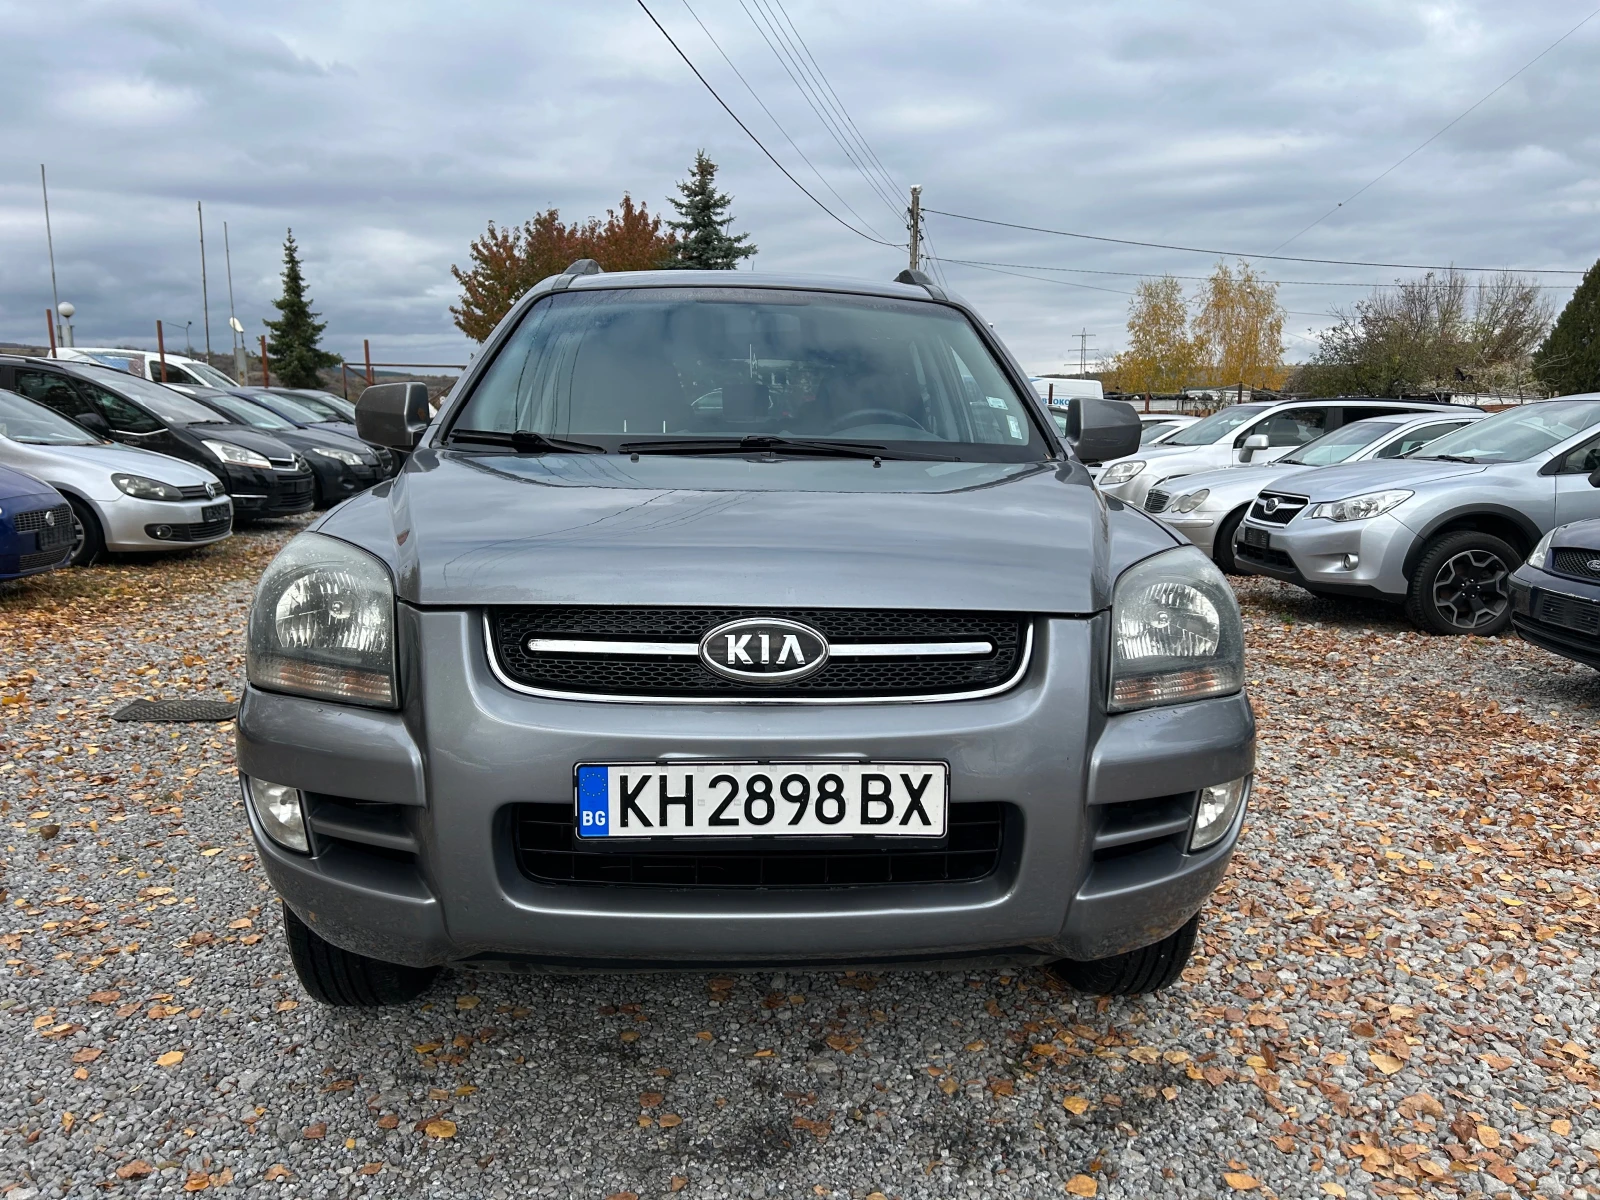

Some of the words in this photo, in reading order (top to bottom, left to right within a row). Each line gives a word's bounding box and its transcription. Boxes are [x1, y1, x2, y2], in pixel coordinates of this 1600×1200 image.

[725, 634, 806, 665] KIA
[619, 774, 694, 827] KH
[708, 774, 846, 826] 2898
[860, 774, 933, 826] BX
[583, 811, 606, 826] BG
